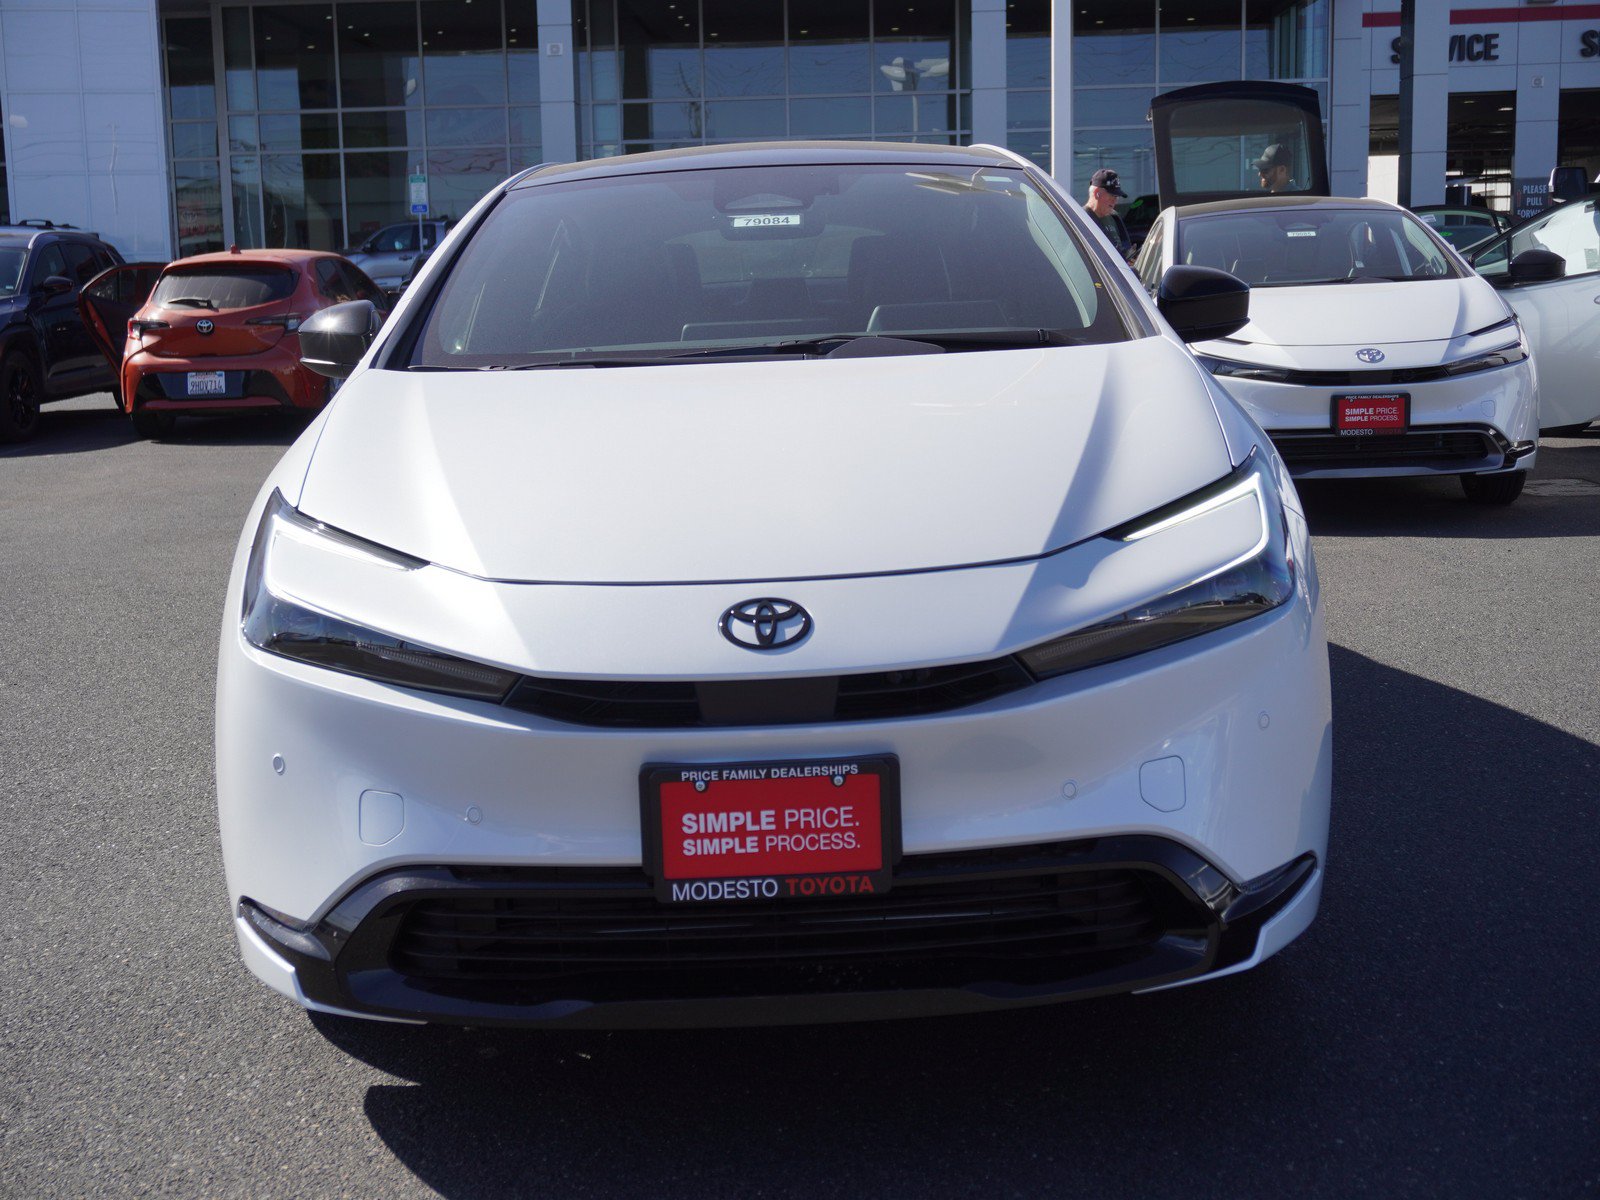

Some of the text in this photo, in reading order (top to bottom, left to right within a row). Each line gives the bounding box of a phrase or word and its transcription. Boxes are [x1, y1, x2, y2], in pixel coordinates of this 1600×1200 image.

[1391, 33, 1499, 64] SVICE
[1580, 29, 1600, 57] S
[1522, 184, 1547, 194] PLEASE
[1526, 197, 1543, 206] PULL
[743, 216, 790, 226] 79084
[1345, 407, 1374, 415] SIMPLE
[681, 764, 859, 782] PRICE FAMILY DEALERSHIPS
[681, 805, 860, 835] SIMPLE PRICE.
[682, 831, 861, 857] SIMPLE PROCESS.
[672, 875, 875, 902] MODESTO TOYOTA
